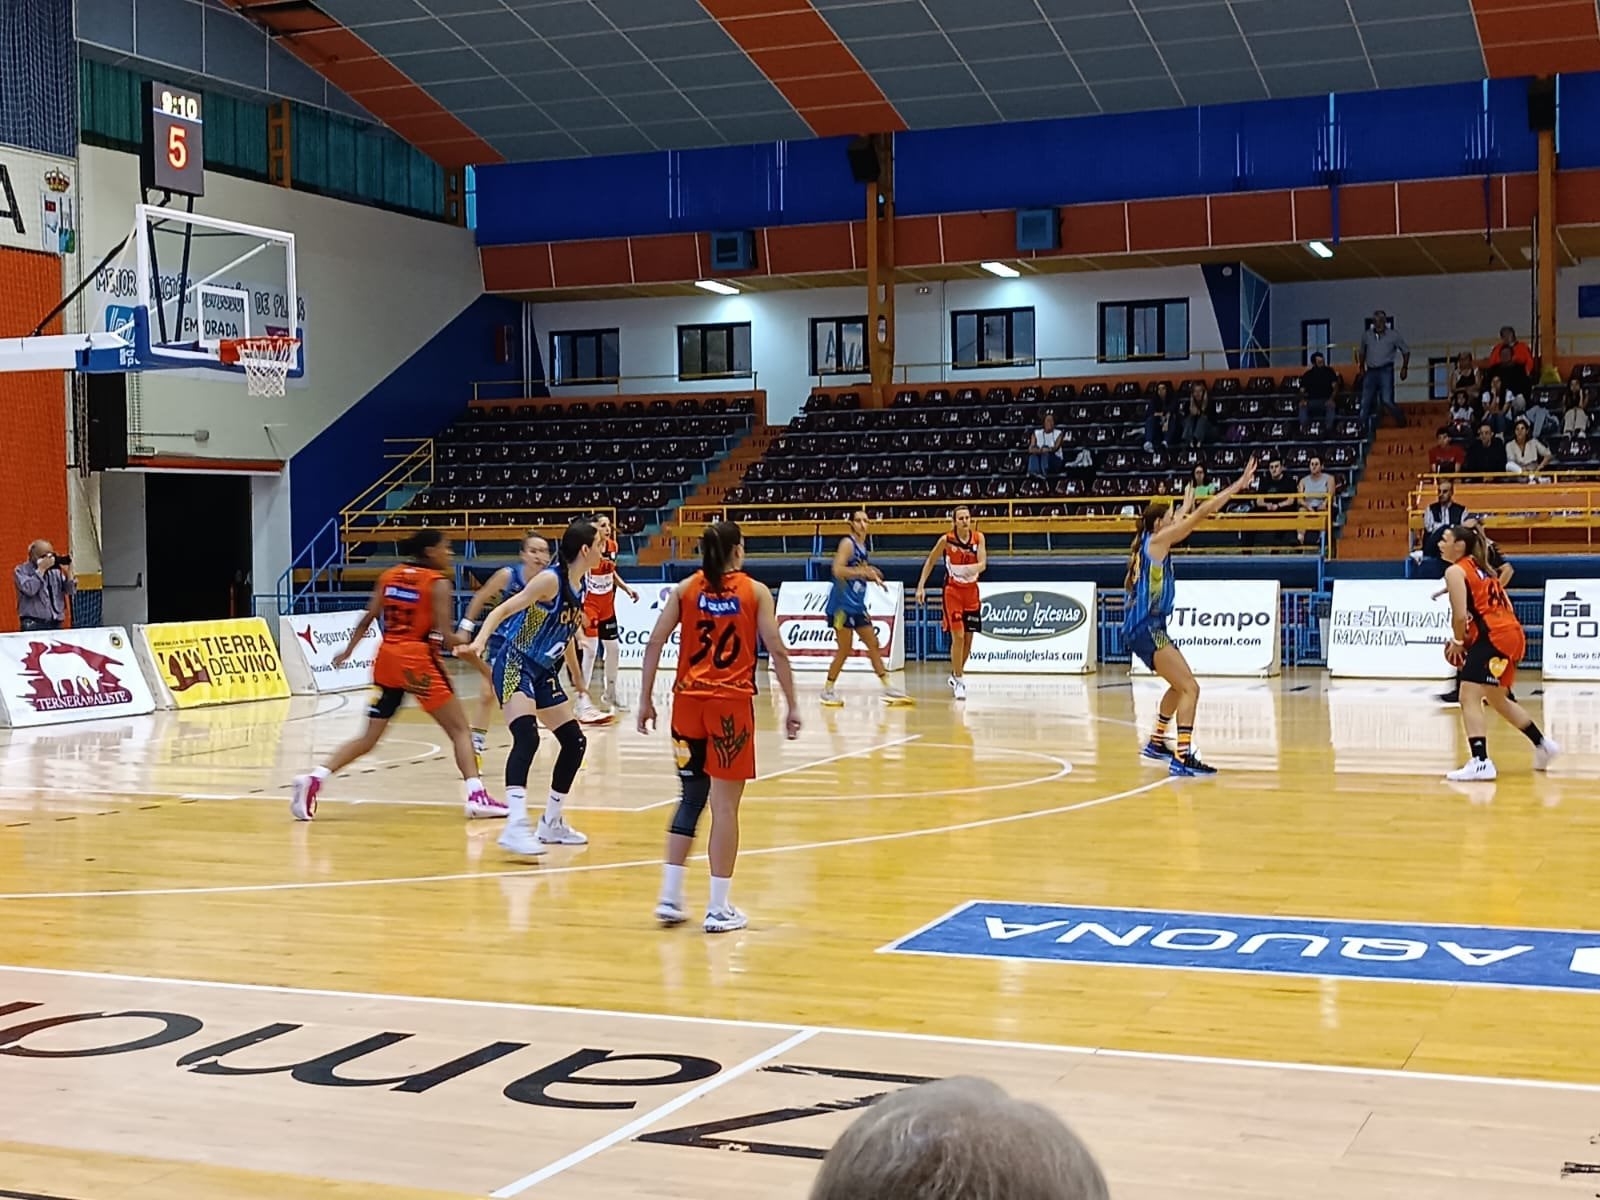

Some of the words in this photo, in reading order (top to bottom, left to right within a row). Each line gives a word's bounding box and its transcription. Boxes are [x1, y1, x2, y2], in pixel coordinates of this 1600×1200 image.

[161, 91, 198, 120] 9:10
[168, 125, 187, 169] 5
[200, 633, 271, 656] TIERRA
[984, 915, 1537, 968] AQUONA
